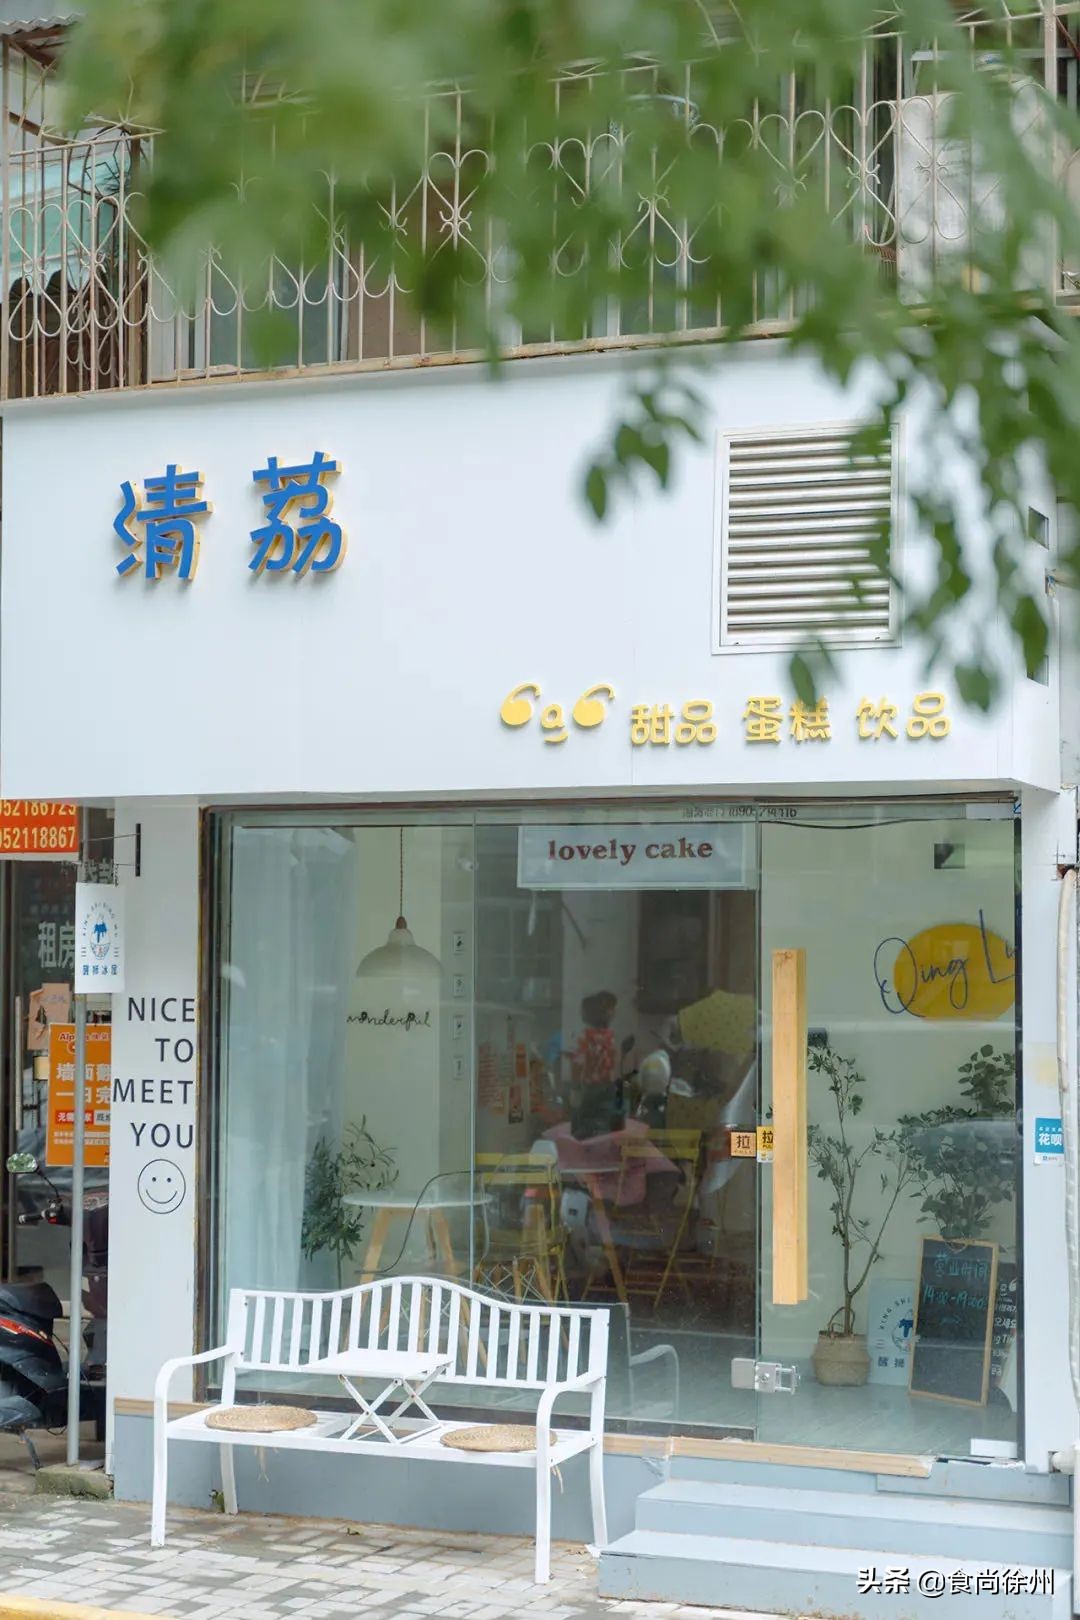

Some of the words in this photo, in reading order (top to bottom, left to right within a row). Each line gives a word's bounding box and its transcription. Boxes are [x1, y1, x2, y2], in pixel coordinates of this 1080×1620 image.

[112, 450, 346, 581] 清荔
[631, 699, 717, 744] 甜品
[743, 695, 832, 744] 蛋糕
[856, 690, 951, 741] 饮品
[0, 826, 76, 849] 52118867
[548, 838, 636, 866] lovely
[645, 837, 713, 859] cake
[128, 997, 195, 1022] NICE
[155, 1038, 194, 1063] TO
[113, 1078, 193, 1104] MEET
[130, 1122, 193, 1149] YOU
[1039, 1133, 1062, 1146] 花呗
